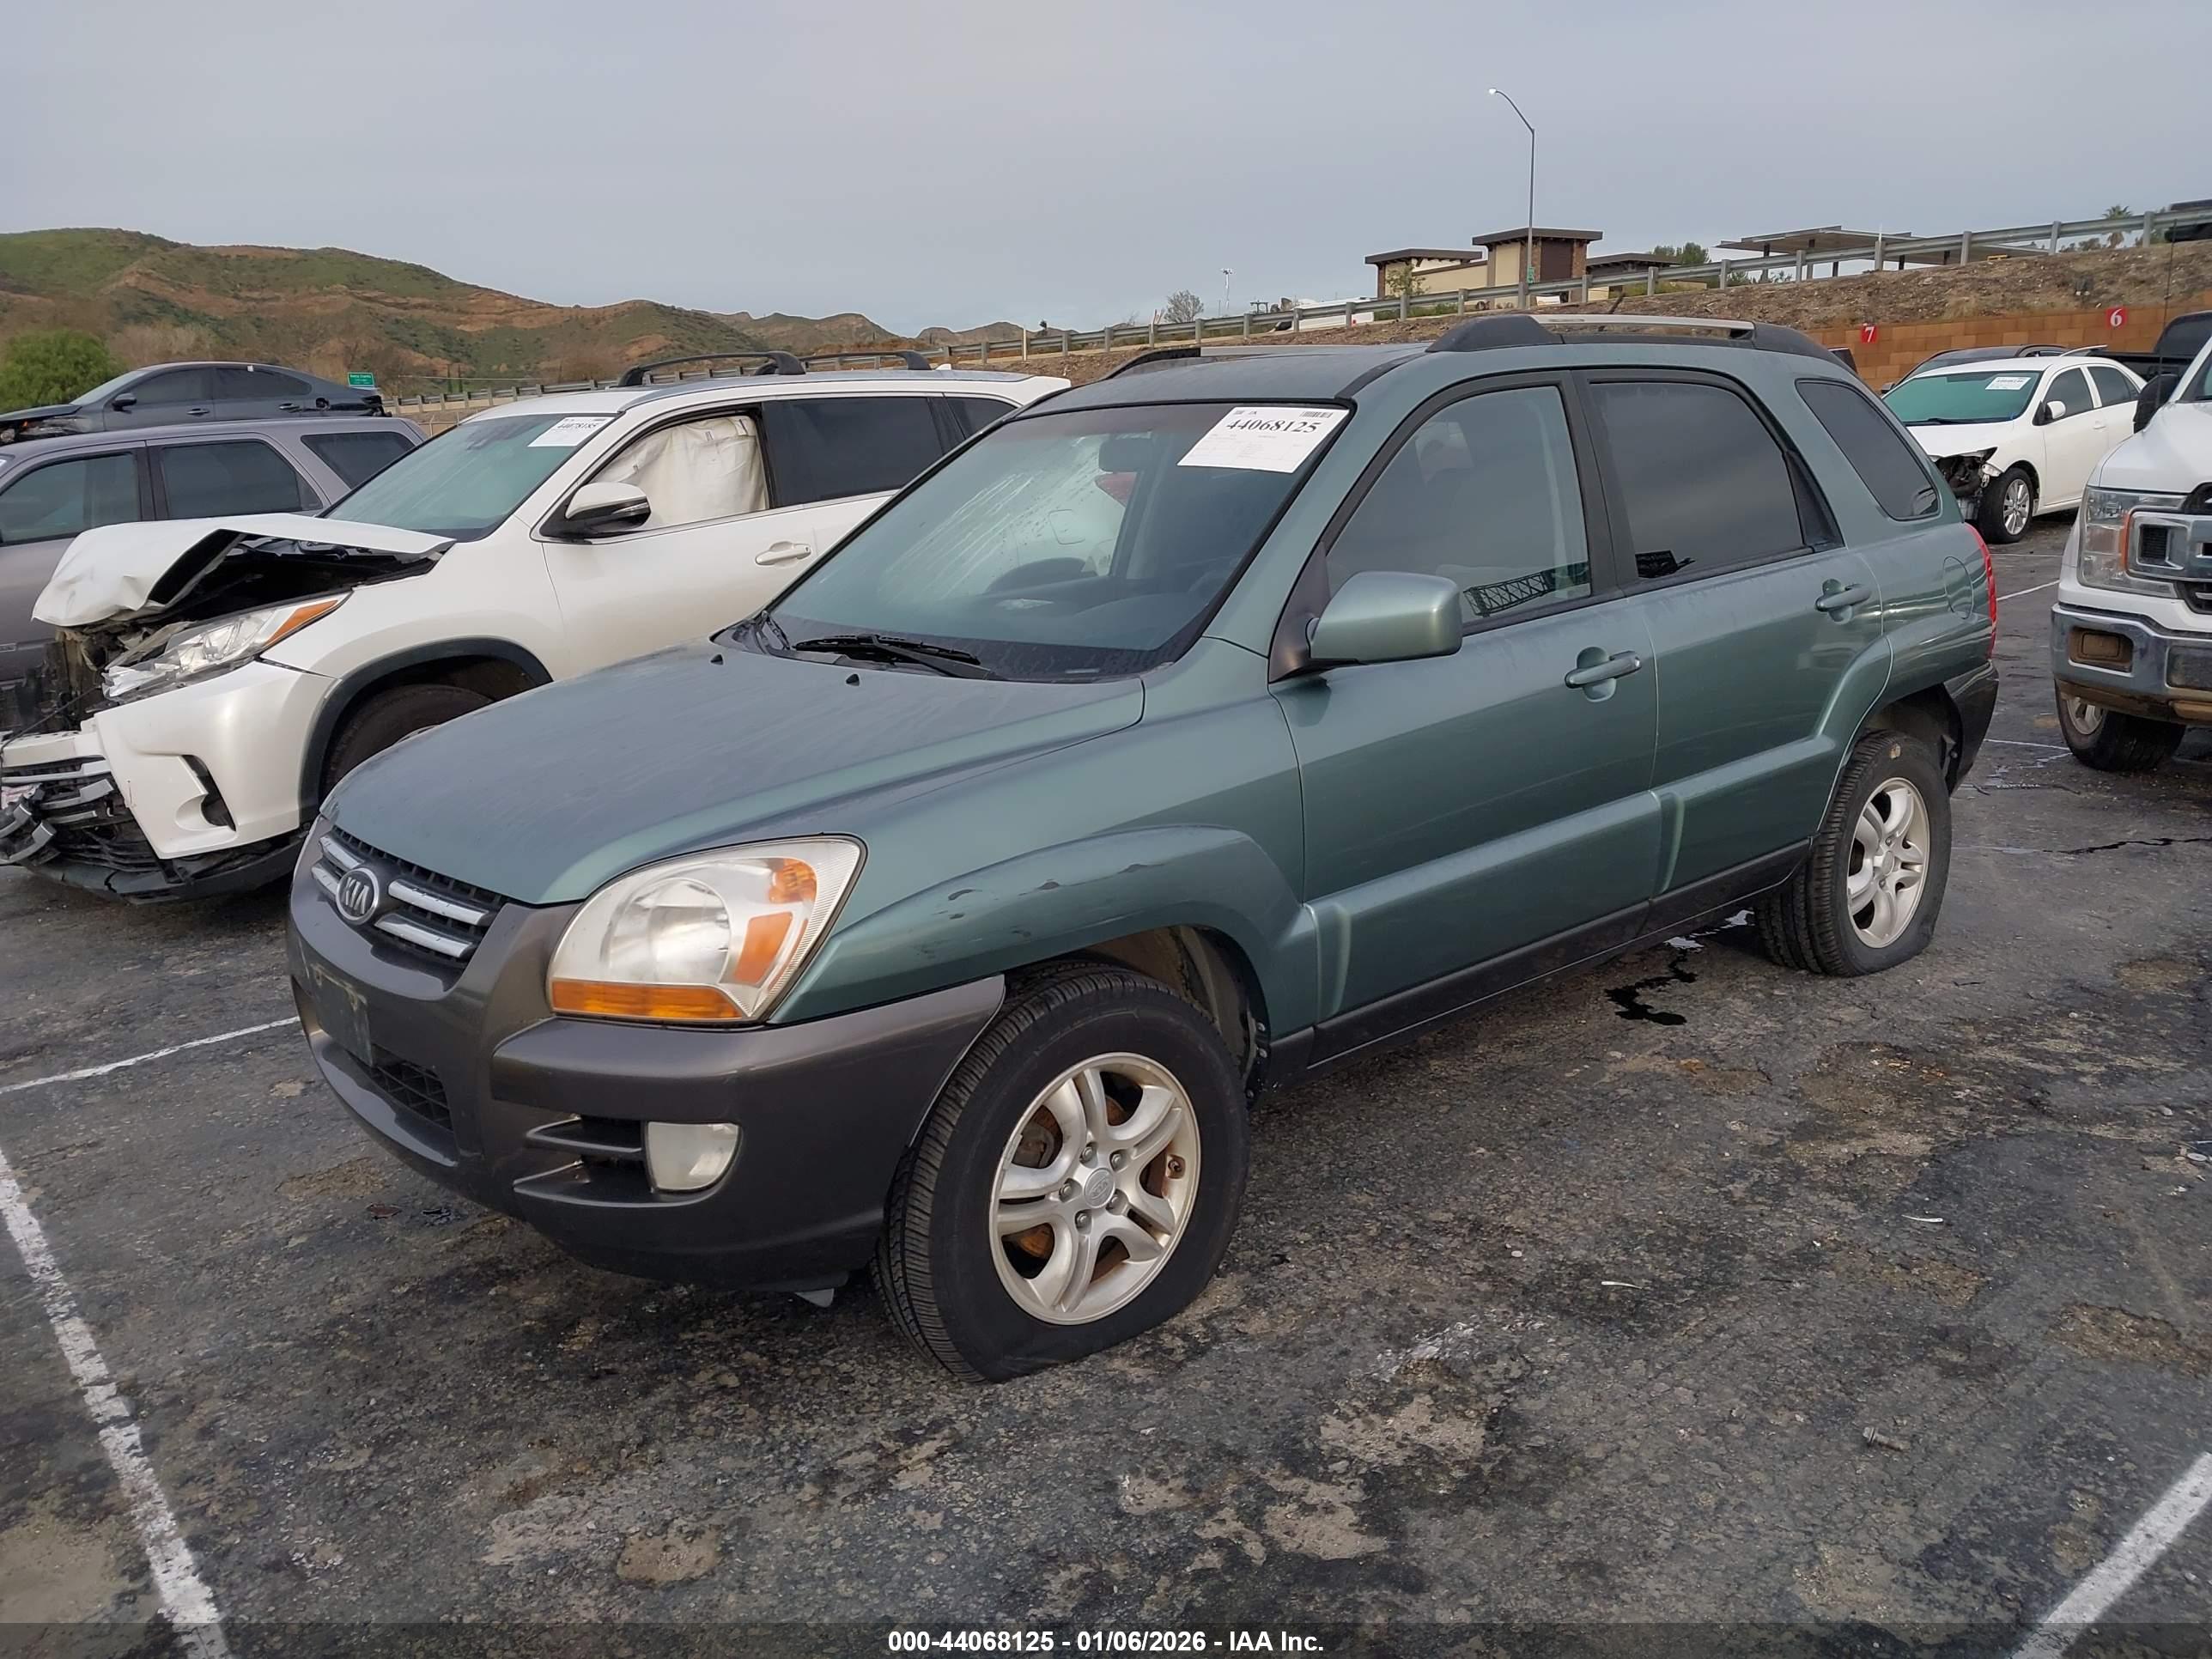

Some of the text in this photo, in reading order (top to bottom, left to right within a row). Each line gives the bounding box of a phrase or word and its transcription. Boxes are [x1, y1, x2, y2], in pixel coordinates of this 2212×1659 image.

[2110, 308, 2122, 327] 6
[1864, 326, 1875, 343] 7
[1227, 419, 1322, 433] 44068125
[341, 877, 369, 915] KIA
